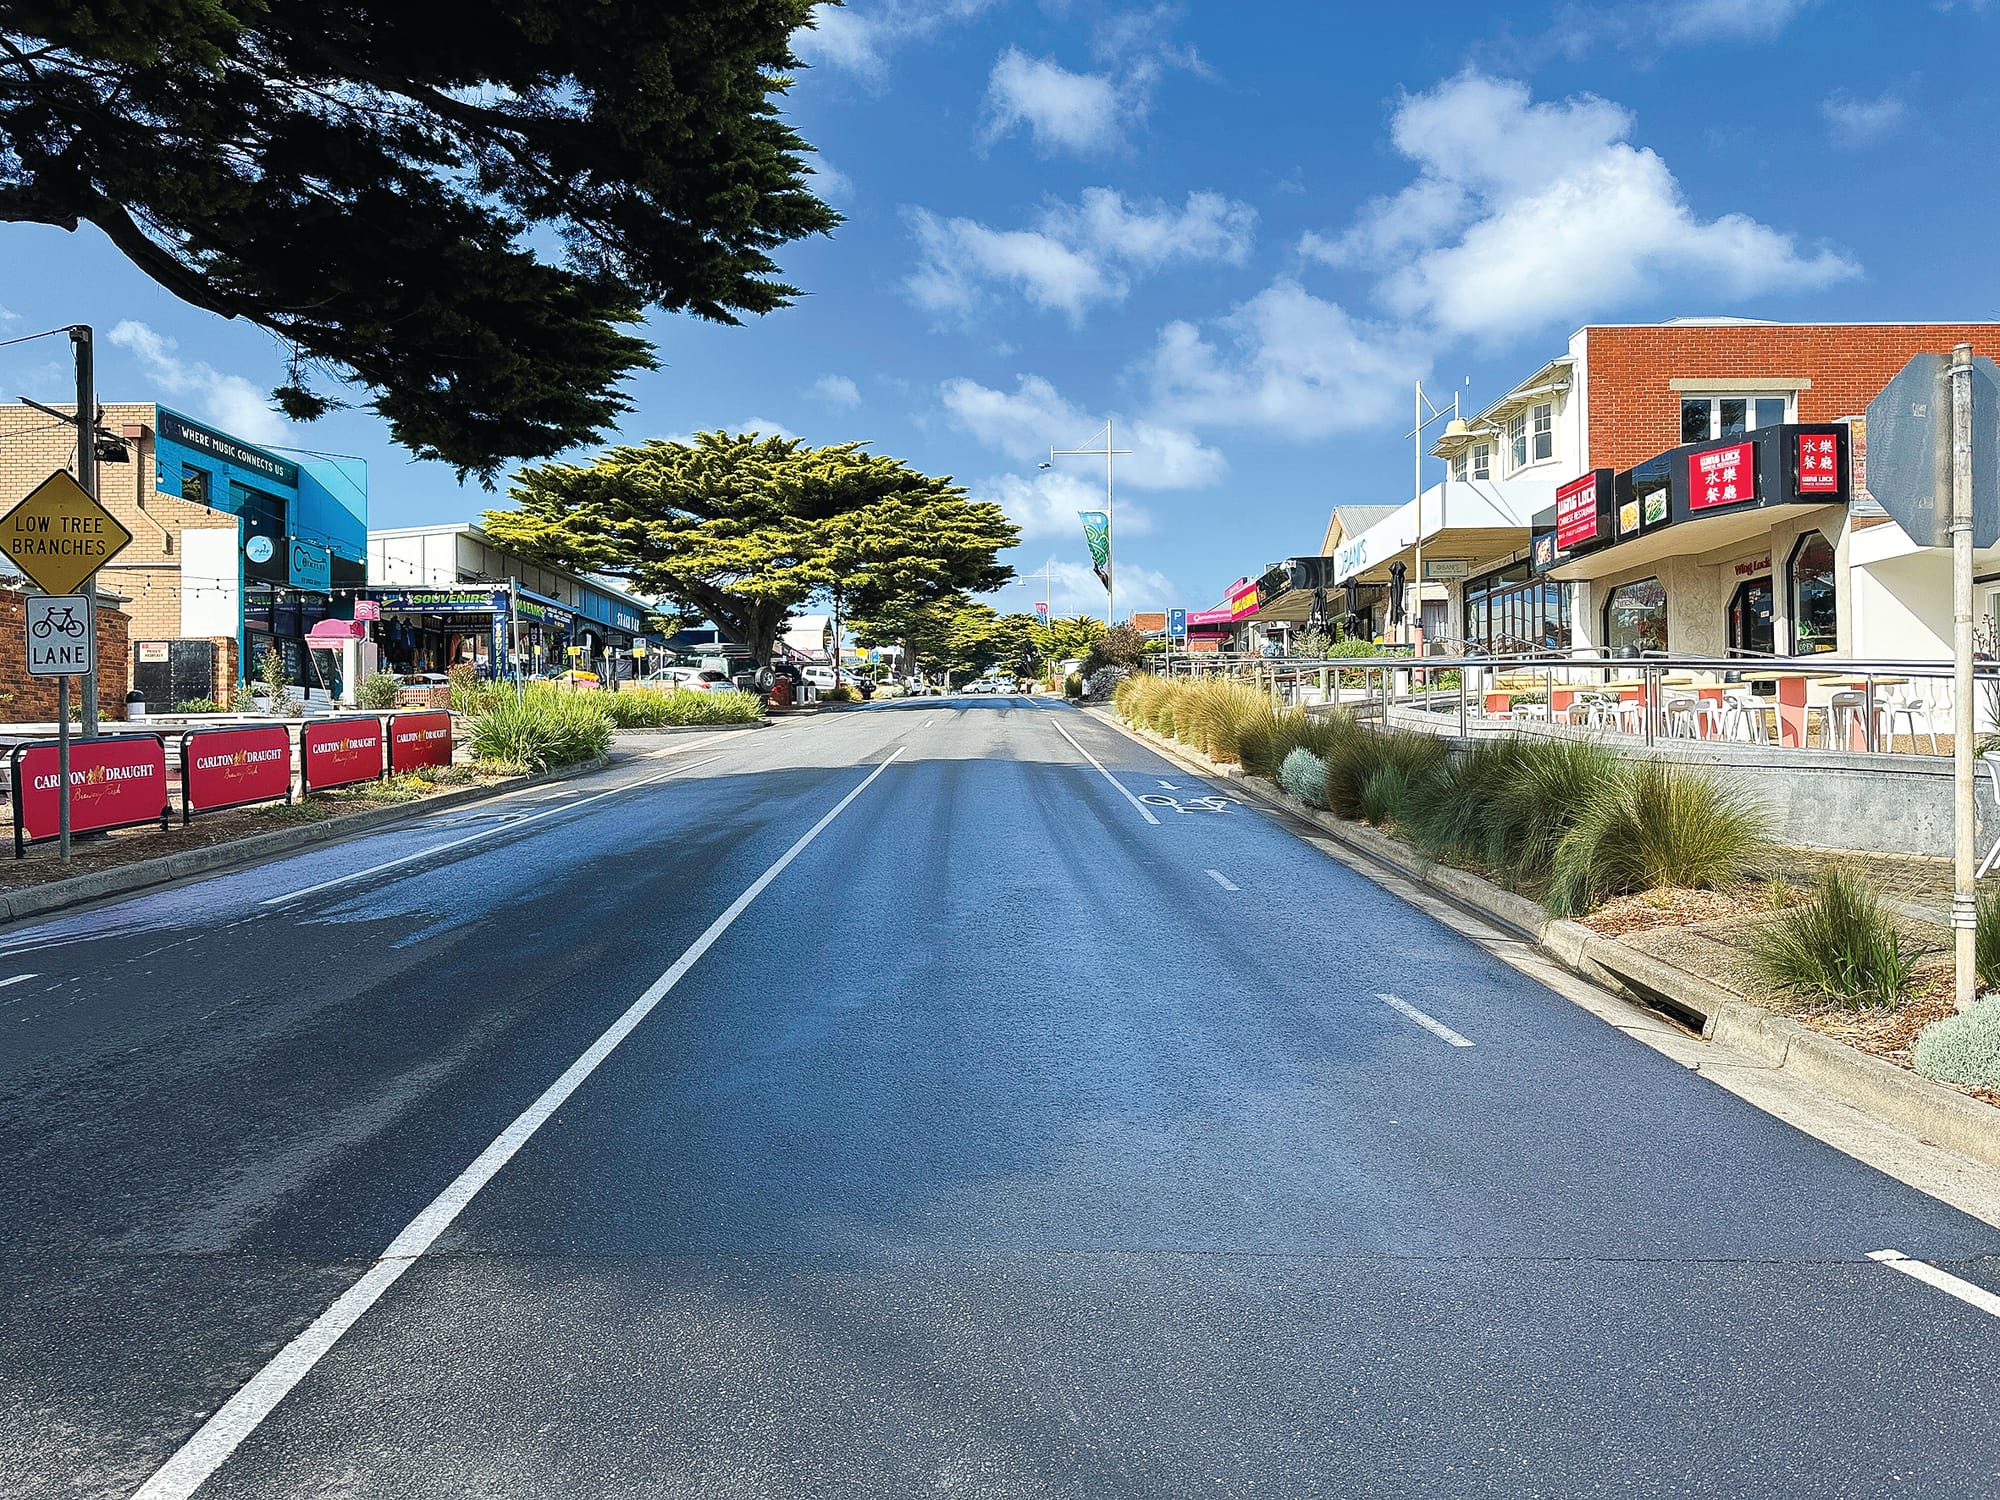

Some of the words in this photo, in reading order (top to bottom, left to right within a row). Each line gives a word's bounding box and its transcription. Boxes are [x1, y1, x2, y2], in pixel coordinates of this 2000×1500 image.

[181, 426, 210, 447] WHERE
[212, 438, 236, 457] MUSIC
[237, 449, 273, 472] CONNECTS
[275, 465, 284, 477] US
[1721, 449, 1740, 462] LOCK
[1578, 485, 1596, 508] LOCK
[15, 516, 50, 533] LOW
[60, 517, 104, 534] TREE
[12, 538, 106, 556] BRANCHES
[1734, 560, 1754, 577] Wing
[413, 593, 488, 605] SOUVENIRS
[1174, 611, 1182, 620] P
[33, 646, 85, 664] LANE
[312, 741, 340, 754] CARLTON
[349, 737, 376, 749] DRAUGHT
[197, 754, 234, 769] CARLTON
[247, 749, 282, 763] DRAUGHT
[34, 770, 86, 789] CARLON
[105, 764, 155, 780] DRAUGHT
